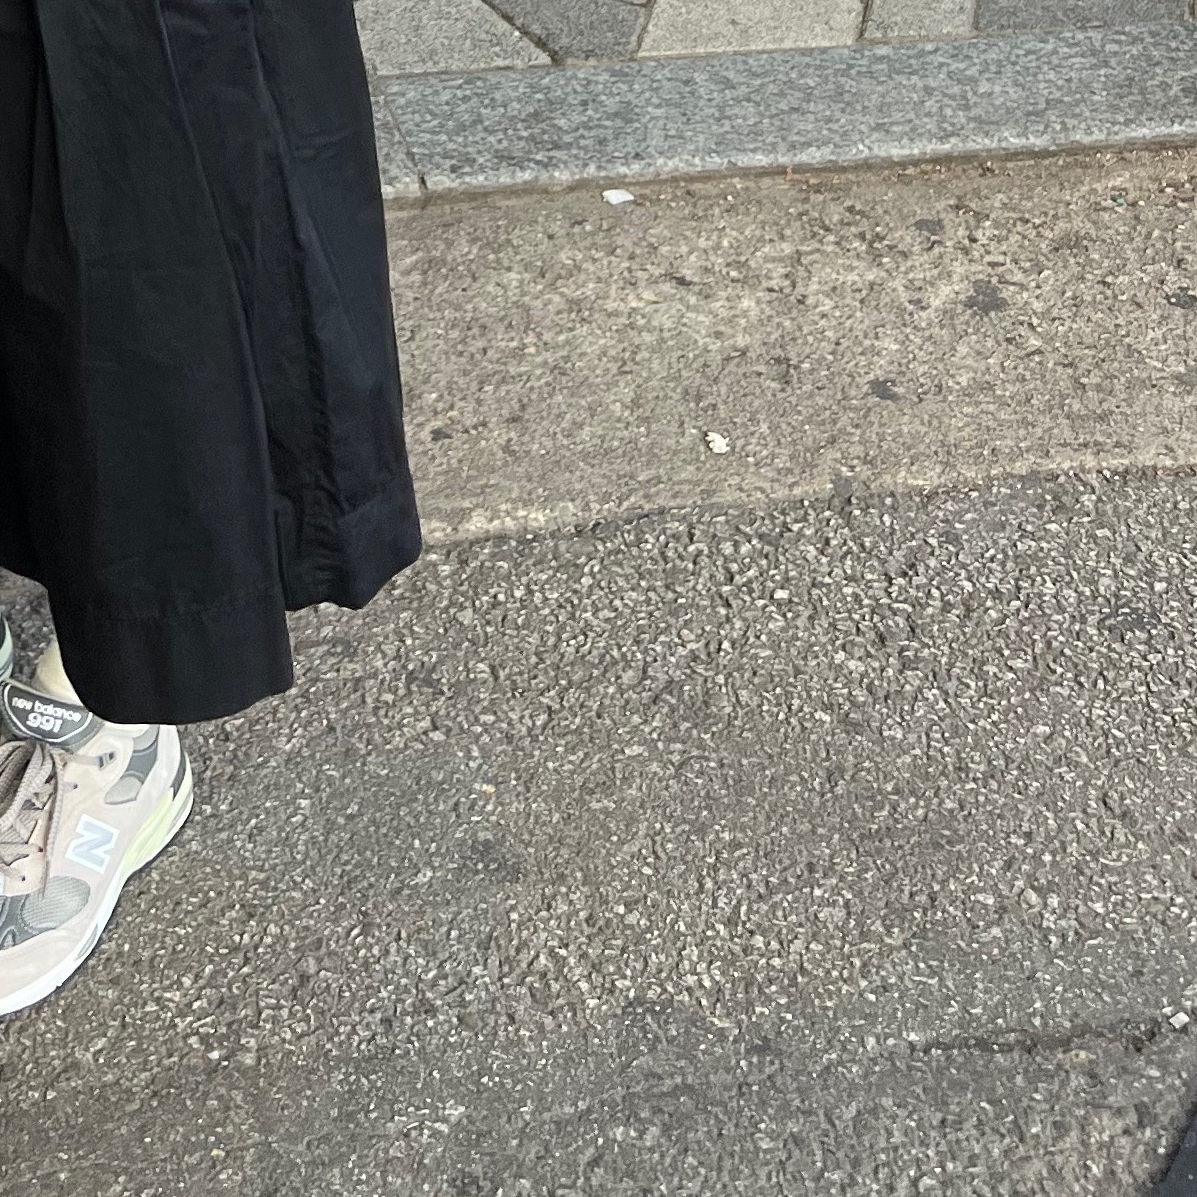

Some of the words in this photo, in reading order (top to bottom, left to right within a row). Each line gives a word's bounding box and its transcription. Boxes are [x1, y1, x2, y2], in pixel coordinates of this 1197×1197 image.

[25, 711, 64, 734] 991
[33, 699, 82, 723] balance
[64, 813, 120, 874] N
